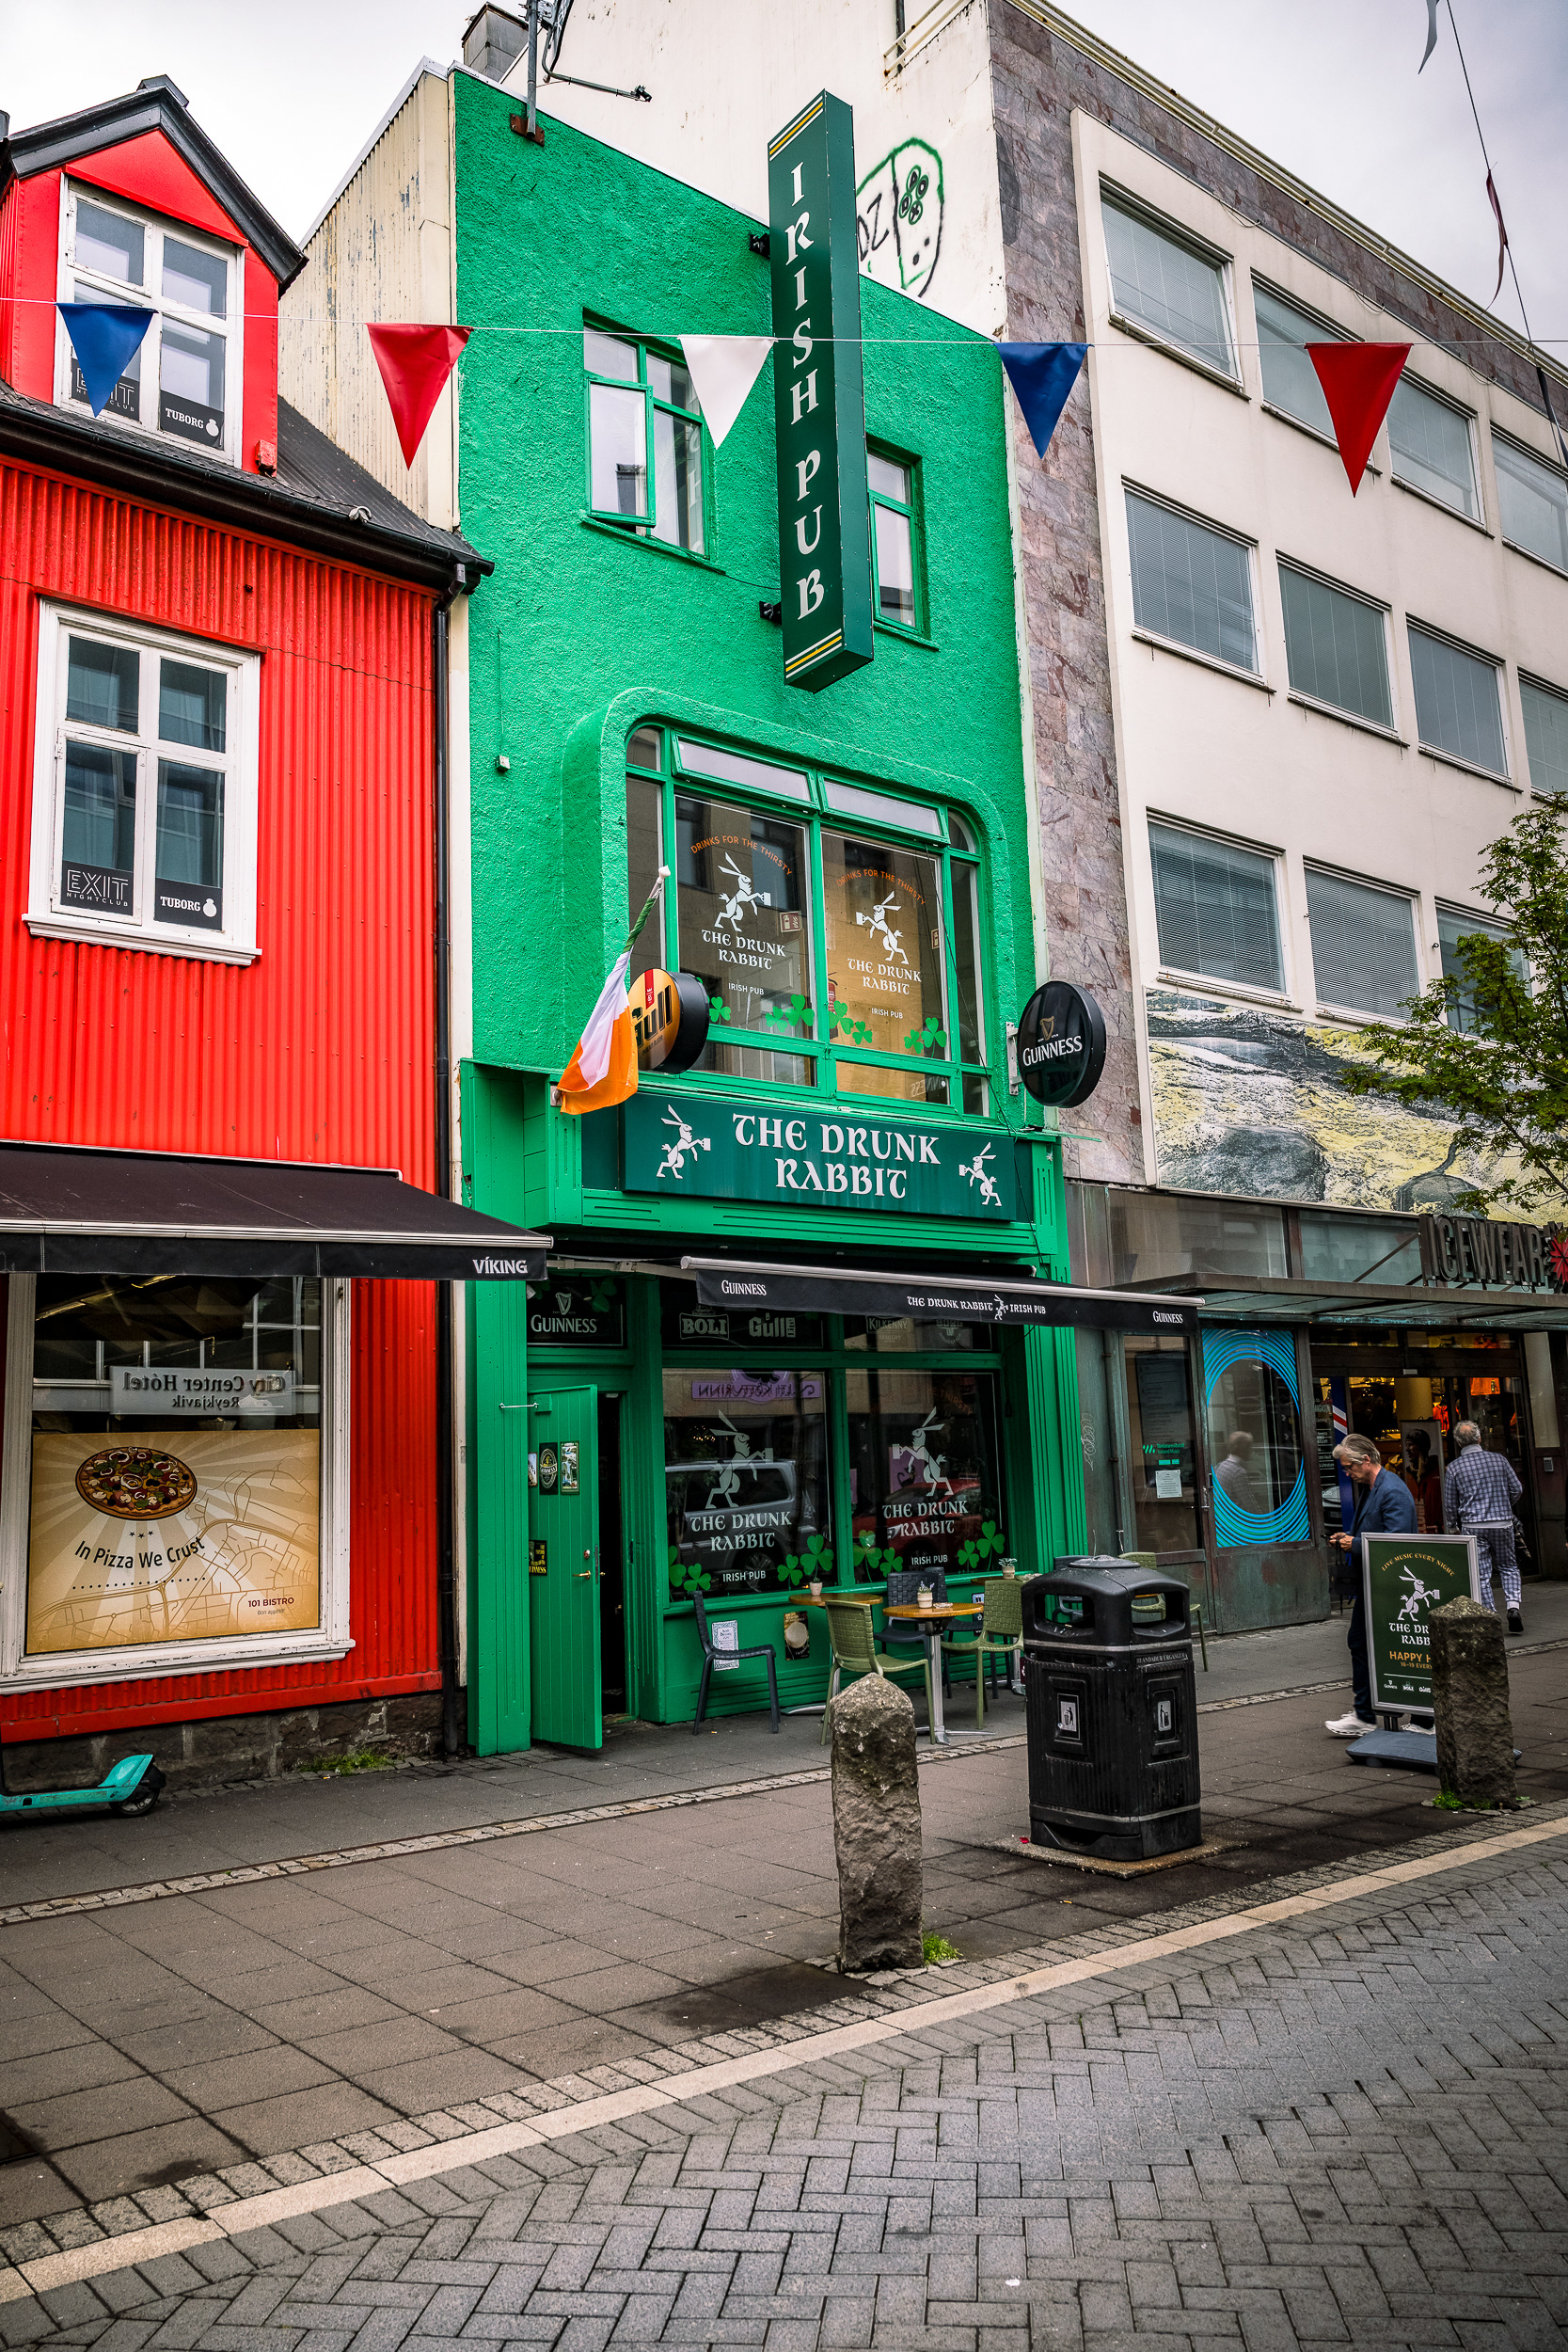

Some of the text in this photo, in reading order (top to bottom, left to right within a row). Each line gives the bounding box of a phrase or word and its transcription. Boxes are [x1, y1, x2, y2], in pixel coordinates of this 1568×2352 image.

[785, 161, 825, 620] IRISH PUB
[76, 388, 135, 412] NICLUB
[165, 407, 204, 429] TUBORG
[690, 835, 793, 876] DRINKS FOR THE THIRSTY
[67, 869, 129, 900] EXIT
[836, 868, 927, 906] DRINKS FOR THE THIRSTY
[66, 892, 129, 907] NIGHTCLUB
[160, 896, 201, 912] TUBORG
[701, 929, 786, 957] THE DRUNK
[718, 948, 772, 970] RABBIT
[847, 958, 922, 982] THE DRUNK
[728, 982, 765, 995] IRISH PUB
[863, 976, 910, 995] RABBIT
[871, 1008, 903, 1019] IRISH PUB
[1022, 1035, 1083, 1066] GUINNESS
[732, 1112, 942, 1165] THE DRUNK
[774, 1157, 908, 1200] RABBIT
[1419, 1214, 1545, 1287] ICEWEAR
[472, 1256, 529, 1274] VÍKING
[721, 1279, 768, 1296] GUINNESS
[907, 1295, 993, 1311] THE DRUNK RABBIT
[1009, 1303, 1046, 1315] IRISH PUB
[530, 1314, 598, 1335] GUINNESS
[681, 1317, 728, 1335] BOLI
[868, 1316, 908, 1330] KILKENNY
[1153, 1311, 1183, 1325] GUINNESS
[881, 1500, 969, 1518] THE DRUNK
[689, 1511, 792, 1532] THE DRUNK
[899, 1520, 955, 1537] RABBIT
[710, 1532, 775, 1551] RABBIT
[74, 1536, 205, 1569] In Pizza We Crust
[911, 1554, 948, 1565] IRISH PUB
[1381, 1552, 1455, 1577] LIVE MUSIC EVERY NIGHT
[722, 1570, 767, 1582] IRISH PUB
[248, 1597, 294, 1608] 101 BISTRO
[1388, 1622, 1411, 1632] THE
[1401, 1634, 1431, 1646] RABB
[1389, 1651, 1422, 1662] HAPPY
